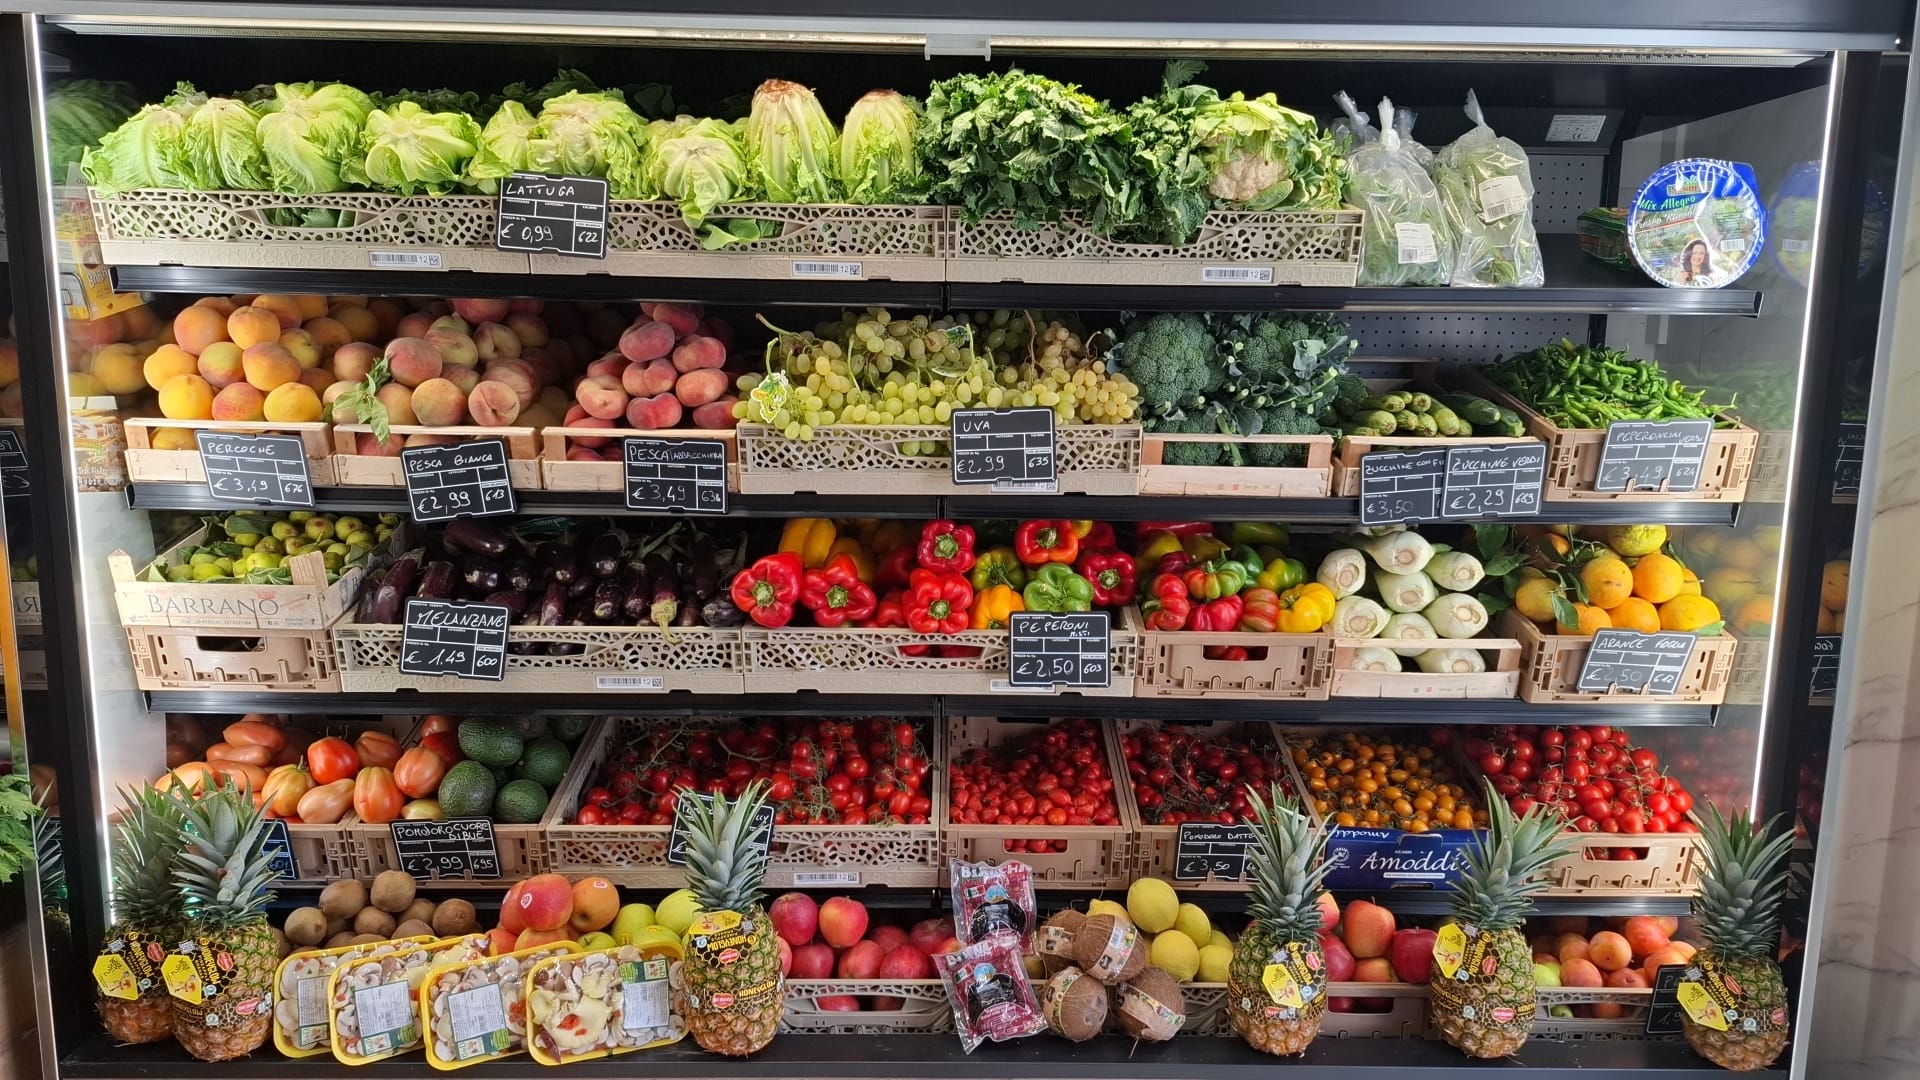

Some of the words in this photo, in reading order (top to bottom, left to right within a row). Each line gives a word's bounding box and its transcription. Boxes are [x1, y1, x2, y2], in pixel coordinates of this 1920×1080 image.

[506, 183, 575, 197] LATTUGA
[1660, 196, 1696, 211] Allegro
[522, 225, 554, 244] 0,99
[578, 230, 598, 243] 622
[963, 420, 990, 432] UVA
[208, 442, 275, 456] PERCOCHE
[630, 445, 668, 462] PESCA
[409, 460, 443, 472] PESCA
[454, 454, 493, 466] BIANCA
[1028, 456, 1049, 468] 635
[1364, 462, 1413, 474] ZUCCHINE
[1452, 457, 1510, 471] ZUCCHINE
[284, 483, 304, 494] 676
[485, 490, 505, 502] 613
[148, 594, 279, 616] BARRANO
[416, 610, 506, 627] MELANZANE
[1598, 638, 1649, 649] ARANCE
[476, 654, 498, 668] 600
[453, 822, 489, 831] CUORE
[473, 858, 494, 870] 695
[1360, 850, 1470, 871] Amoddi
[200, 945, 221, 985] HONEYGLOW
[1706, 970, 1738, 1010] HONEYGLOW
